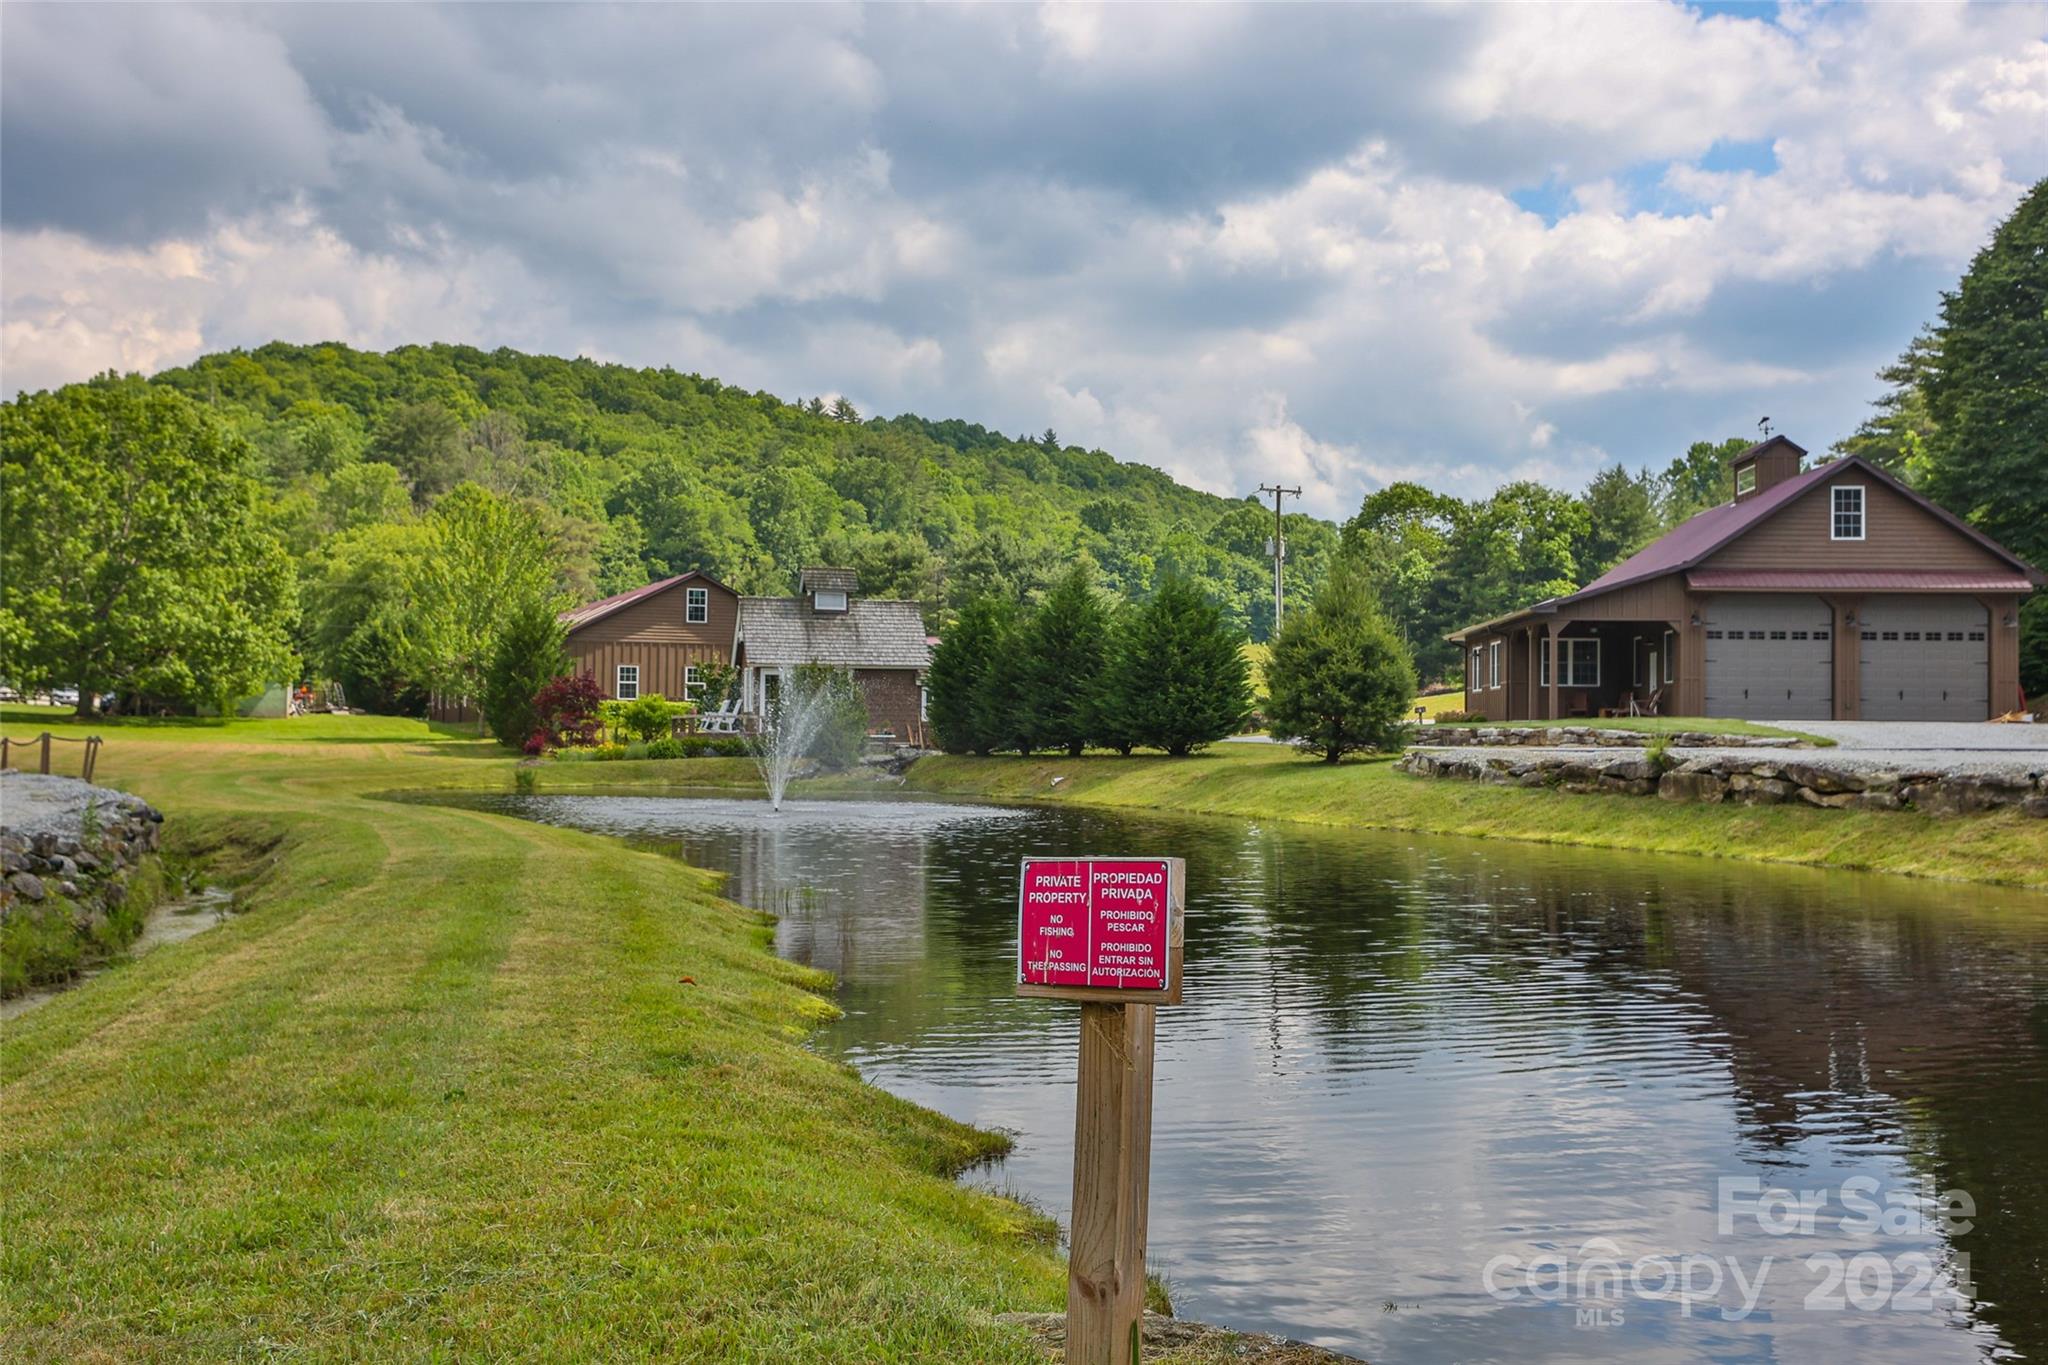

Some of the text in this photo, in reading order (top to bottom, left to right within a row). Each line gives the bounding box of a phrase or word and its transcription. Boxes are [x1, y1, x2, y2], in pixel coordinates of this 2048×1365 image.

[1036, 876, 1081, 887] PRIVATE
[1094, 873, 1162, 884] PROPIEDAD
[1029, 893, 1086, 903] PROPERTY
[1102, 889, 1152, 899] PRIVADA
[1050, 915, 1063, 923] NO
[1100, 911, 1153, 920] PROHIBIDO
[1040, 927, 1074, 936] FISHING
[1108, 923, 1144, 932] PESCAR
[1101, 943, 1151, 952] PROHIBIDO
[1050, 950, 1062, 958] NO
[1099, 955, 1153, 965] ENTRAR SIN
[1092, 967, 1160, 978] AUTORIZACIÓN
